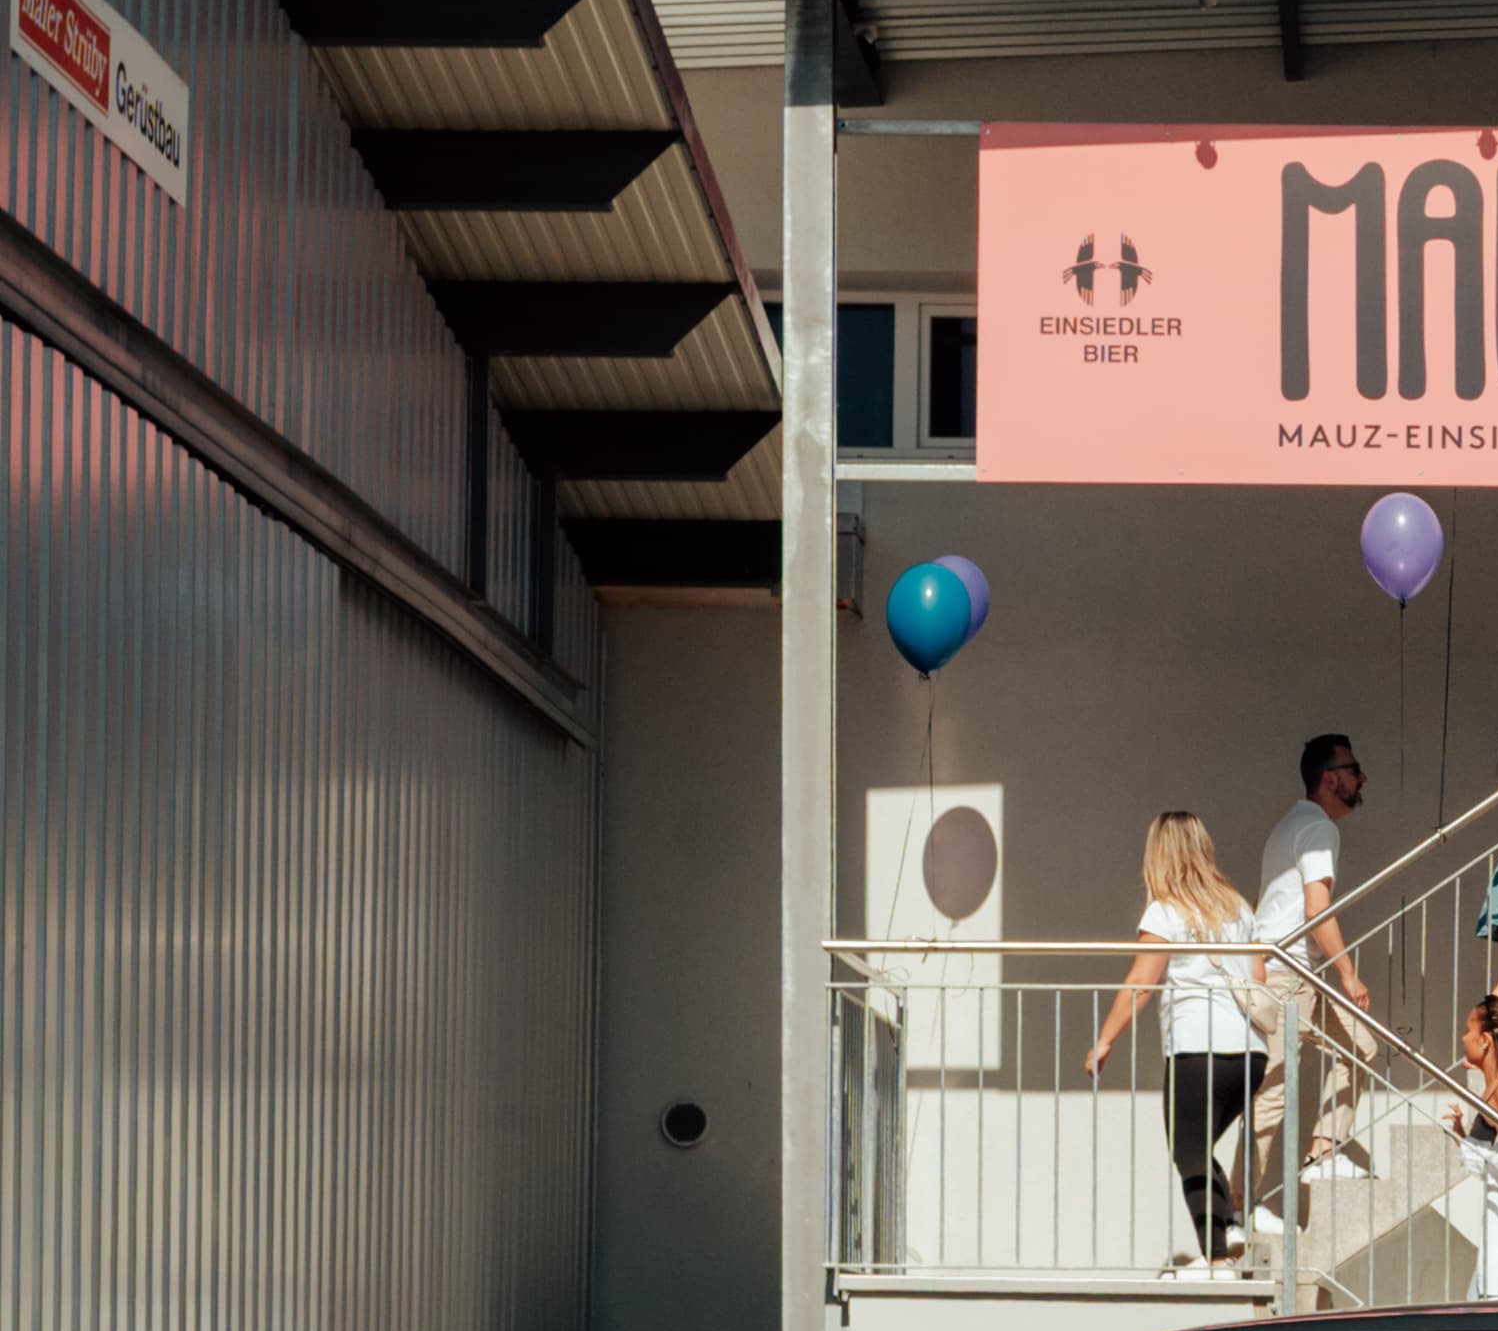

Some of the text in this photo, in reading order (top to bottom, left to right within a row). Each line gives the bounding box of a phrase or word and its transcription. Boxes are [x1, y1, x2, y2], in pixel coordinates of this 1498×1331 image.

[63, 6, 107, 96] Strüby
[115, 61, 181, 168] Gerüstbau
[1039, 316, 1182, 337] EINSIEDLER
[1083, 345, 1139, 364] BIER
